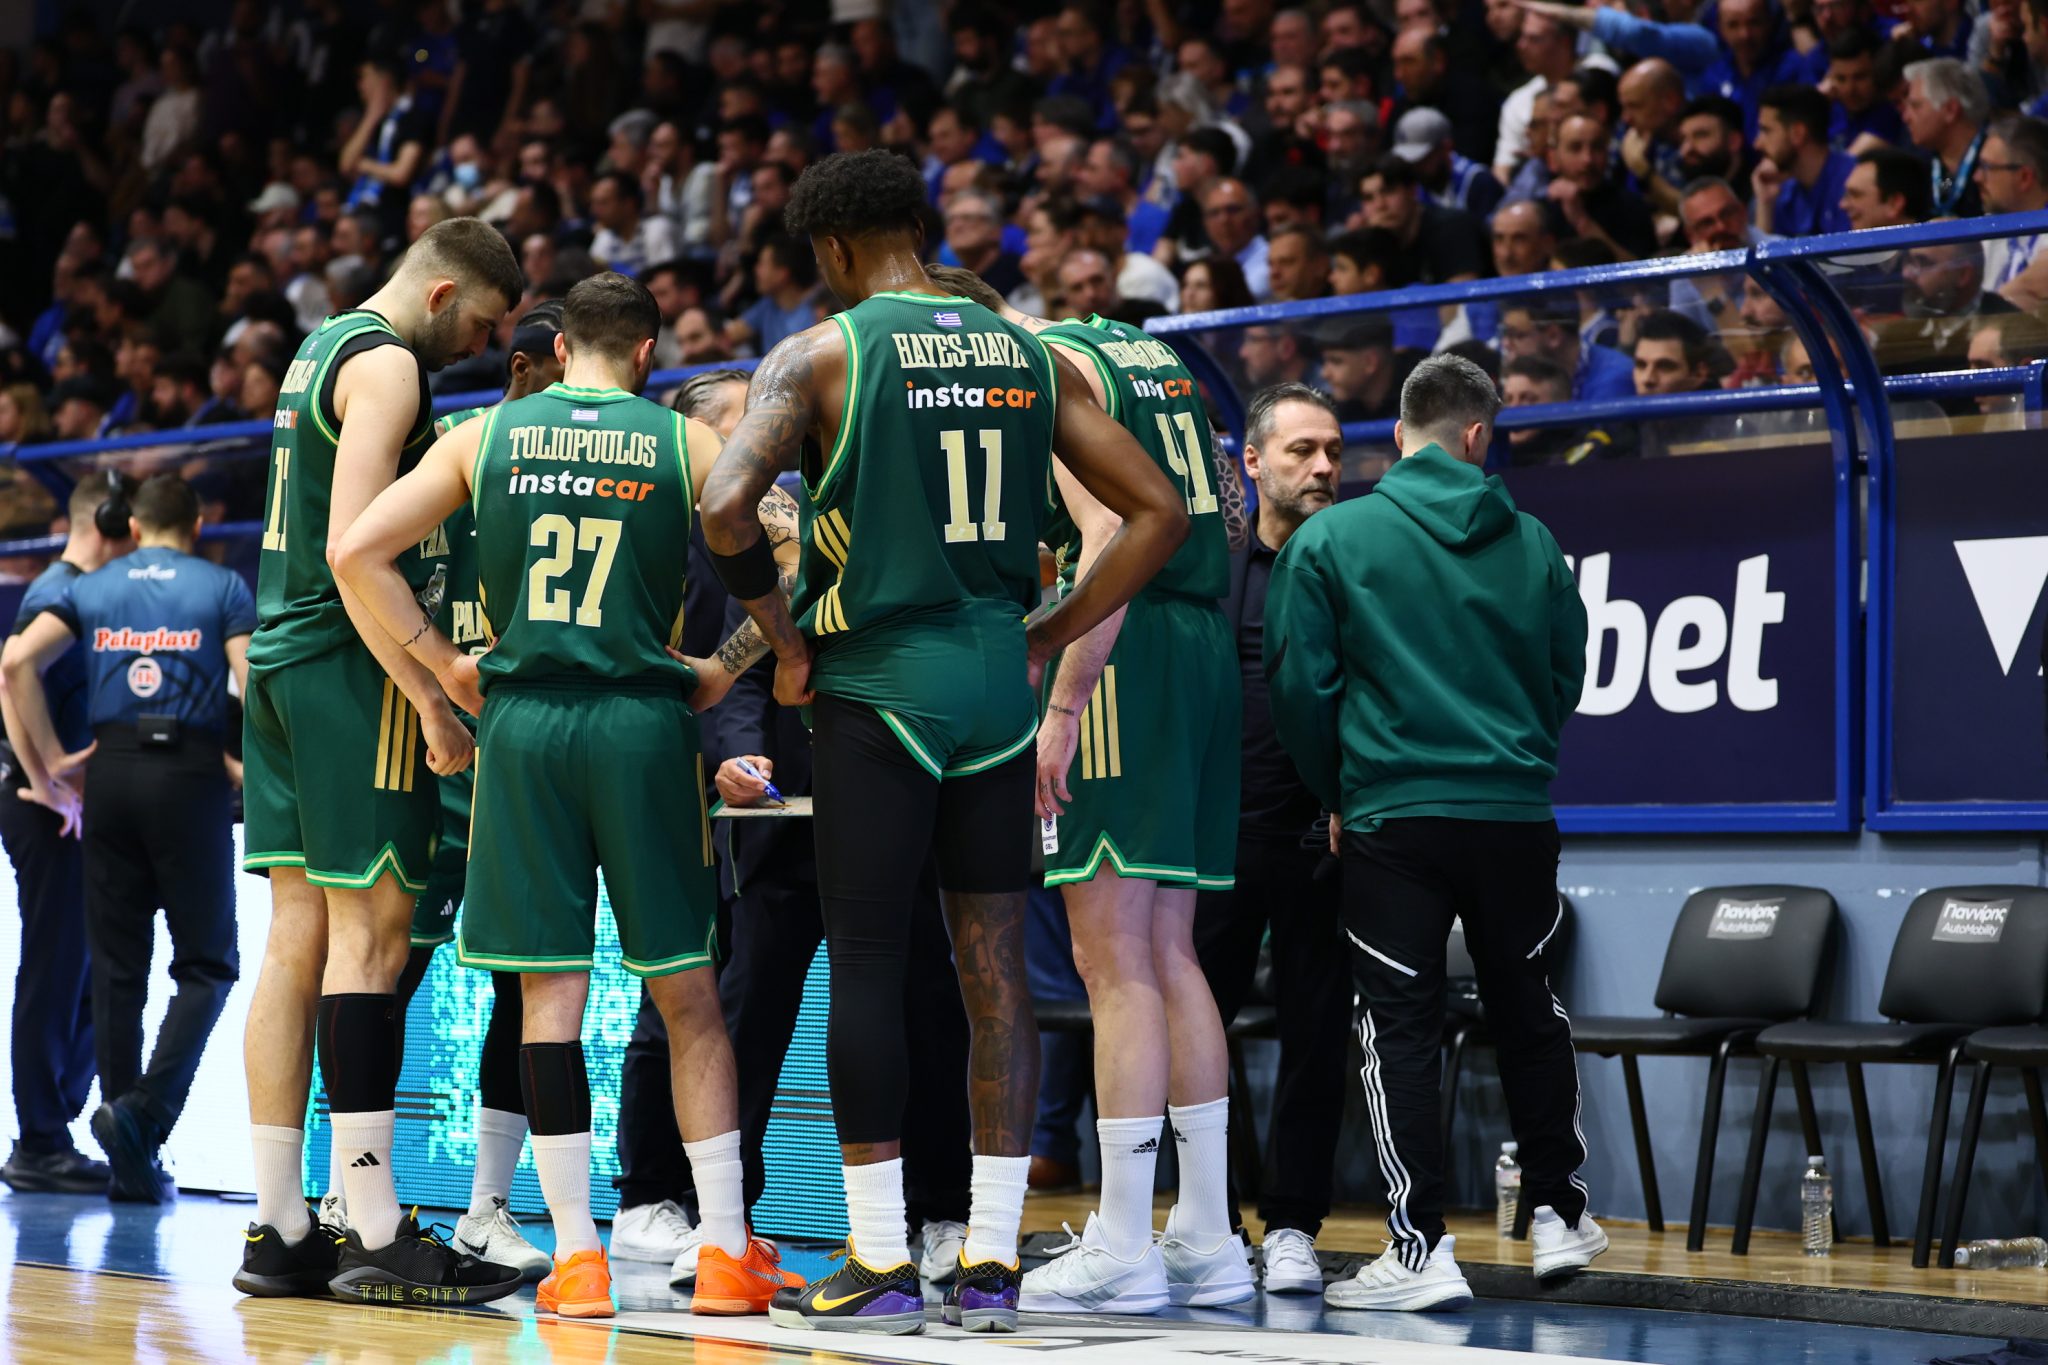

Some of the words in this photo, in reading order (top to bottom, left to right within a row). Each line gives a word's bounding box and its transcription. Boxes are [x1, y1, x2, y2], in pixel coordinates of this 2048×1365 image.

[906, 380, 1037, 409] instacar
[509, 425, 657, 468] TOLIOPOULOS
[1155, 411, 1219, 515] 41
[508, 466, 655, 502] instacar
[940, 428, 1006, 543] 11
[528, 513, 623, 628] 27
[94, 627, 201, 655] Palaplast
[1563, 551, 1785, 716] bet
[360, 1284, 404, 1301] THE
